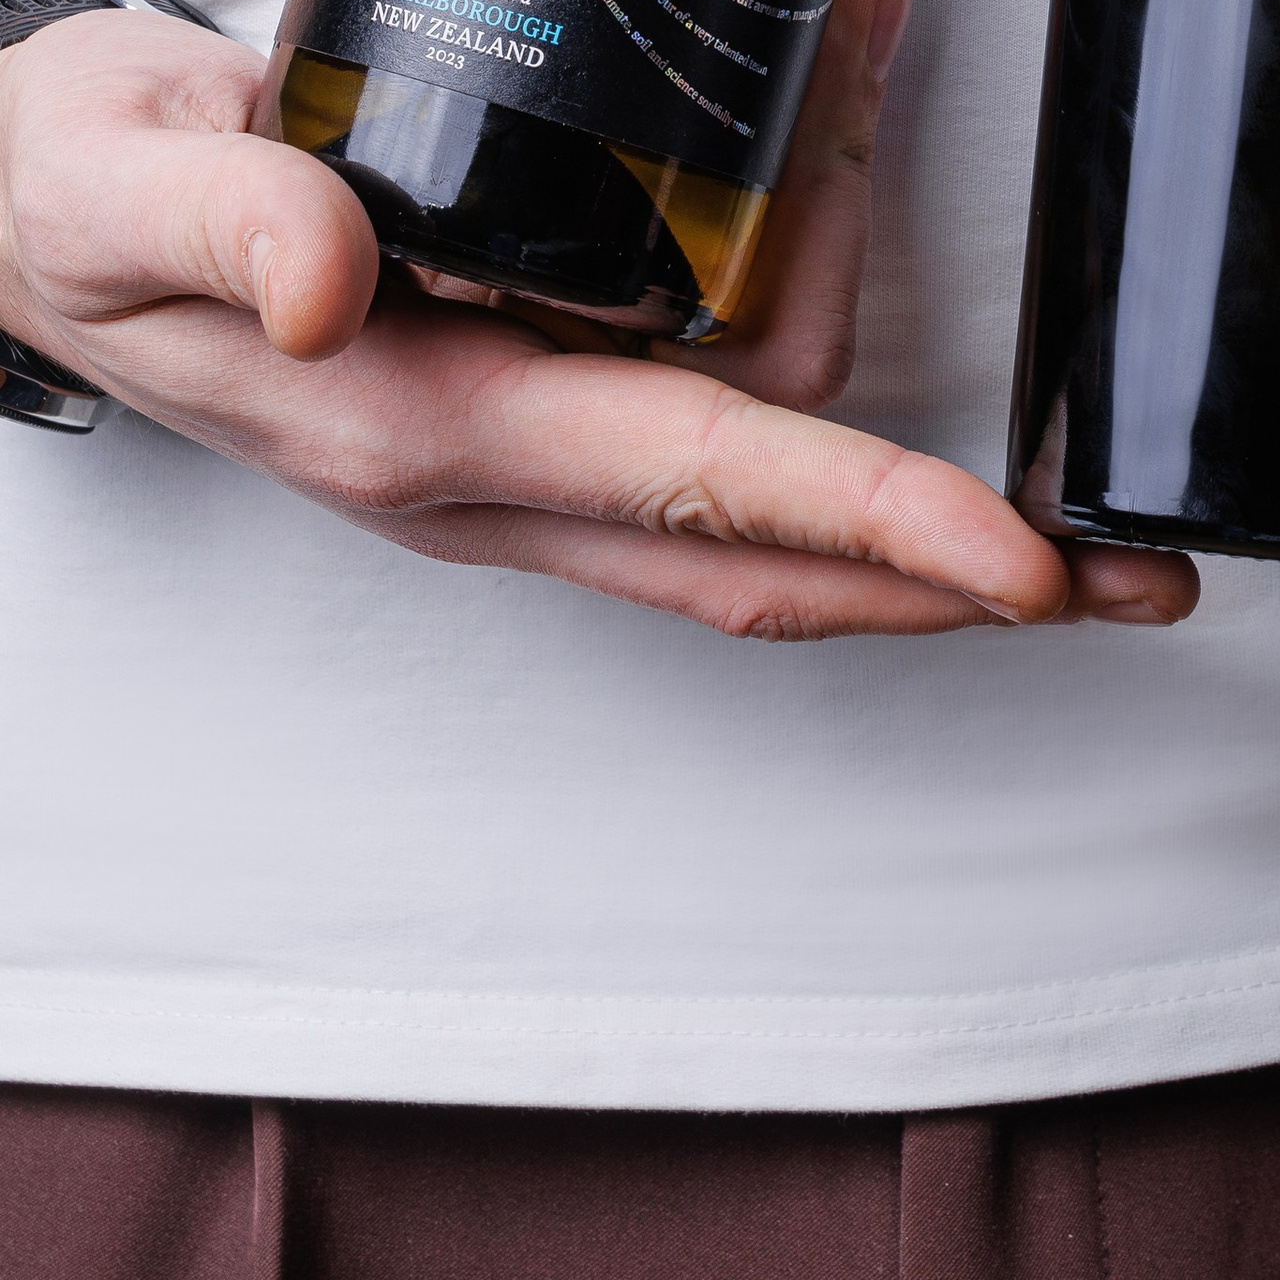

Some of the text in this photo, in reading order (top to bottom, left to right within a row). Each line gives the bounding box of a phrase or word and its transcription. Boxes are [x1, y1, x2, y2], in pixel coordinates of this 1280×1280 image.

[370, 1, 545, 68] NEW ZEALAND
[425, 46, 465, 70] 2023
[675, 10, 691, 24] of
[694, 24, 715, 46] very
[714, 39, 750, 67] talented
[631, 30, 652, 52] soil
[648, 49, 669, 70] and
[665, 67, 698, 100] science
[697, 95, 732, 127] soulfully
